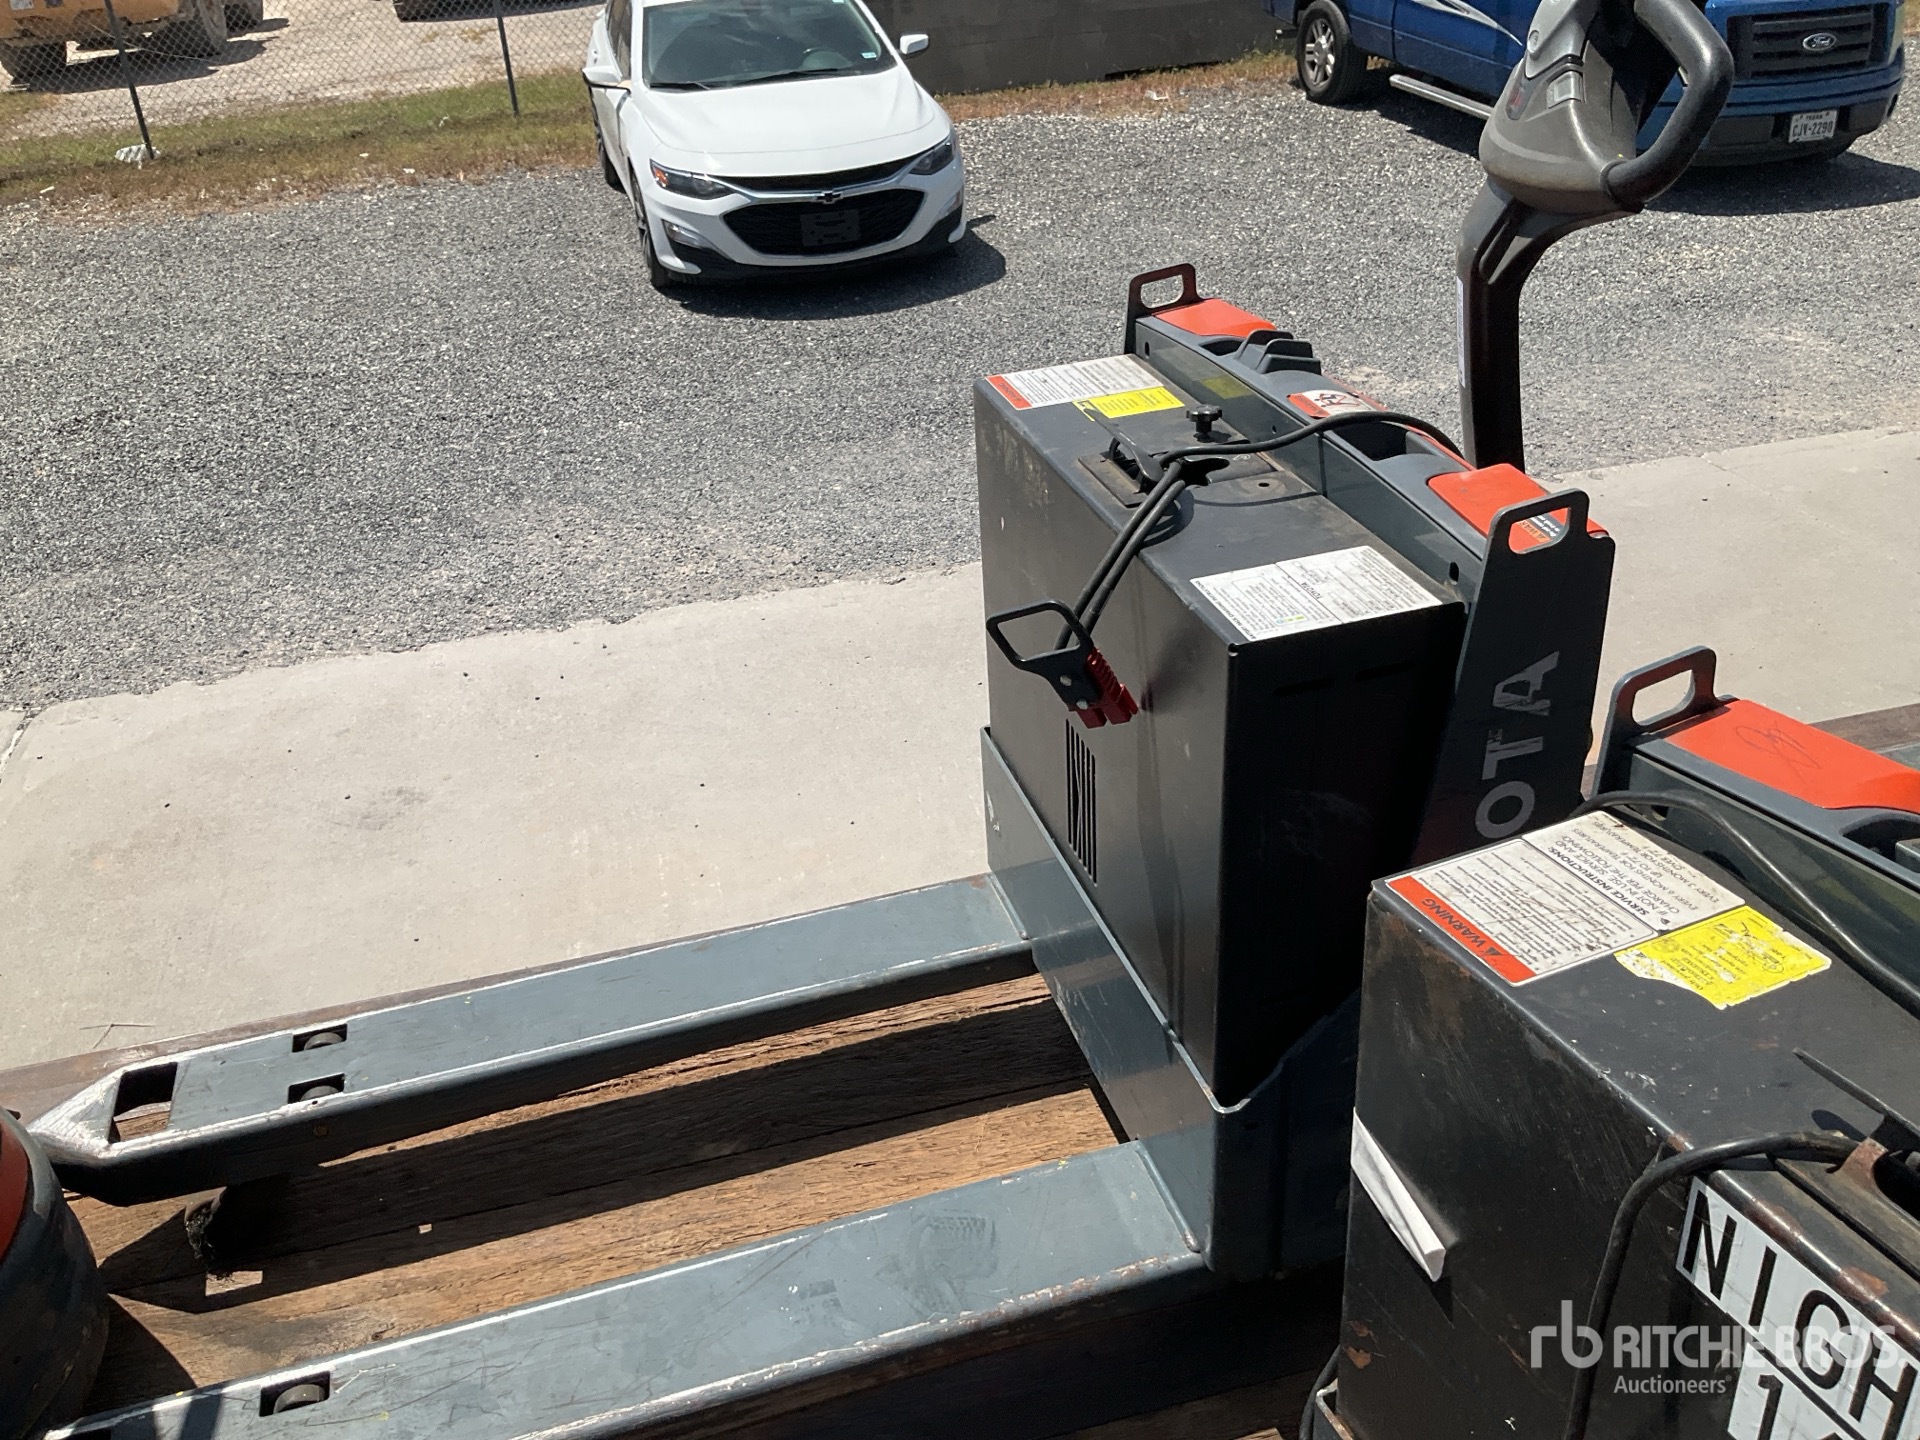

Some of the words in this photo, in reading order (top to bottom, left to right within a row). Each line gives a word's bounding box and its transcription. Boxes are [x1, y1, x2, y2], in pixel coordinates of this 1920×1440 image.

[1298, 581, 1324, 599] TOYOTA
[1552, 839, 1577, 853] AND
[1572, 853, 1608, 875] SERVICE
[1617, 859, 1637, 870] FOR
[1638, 852, 1658, 862] FOR
[1545, 846, 1614, 890] INSTRUCTIONS:
[1607, 867, 1629, 879] THE
[1653, 861, 1691, 883] MONTHS
[1624, 878, 1644, 889] PER
[1632, 868, 1669, 891] MONTHS
[1609, 890, 1649, 915] SERVICE
[1634, 894, 1660, 909] NOT
[1639, 888, 1681, 914] CHARGE
[1670, 894, 1699, 910] EVERY
[1418, 896, 1489, 947] WARNING
